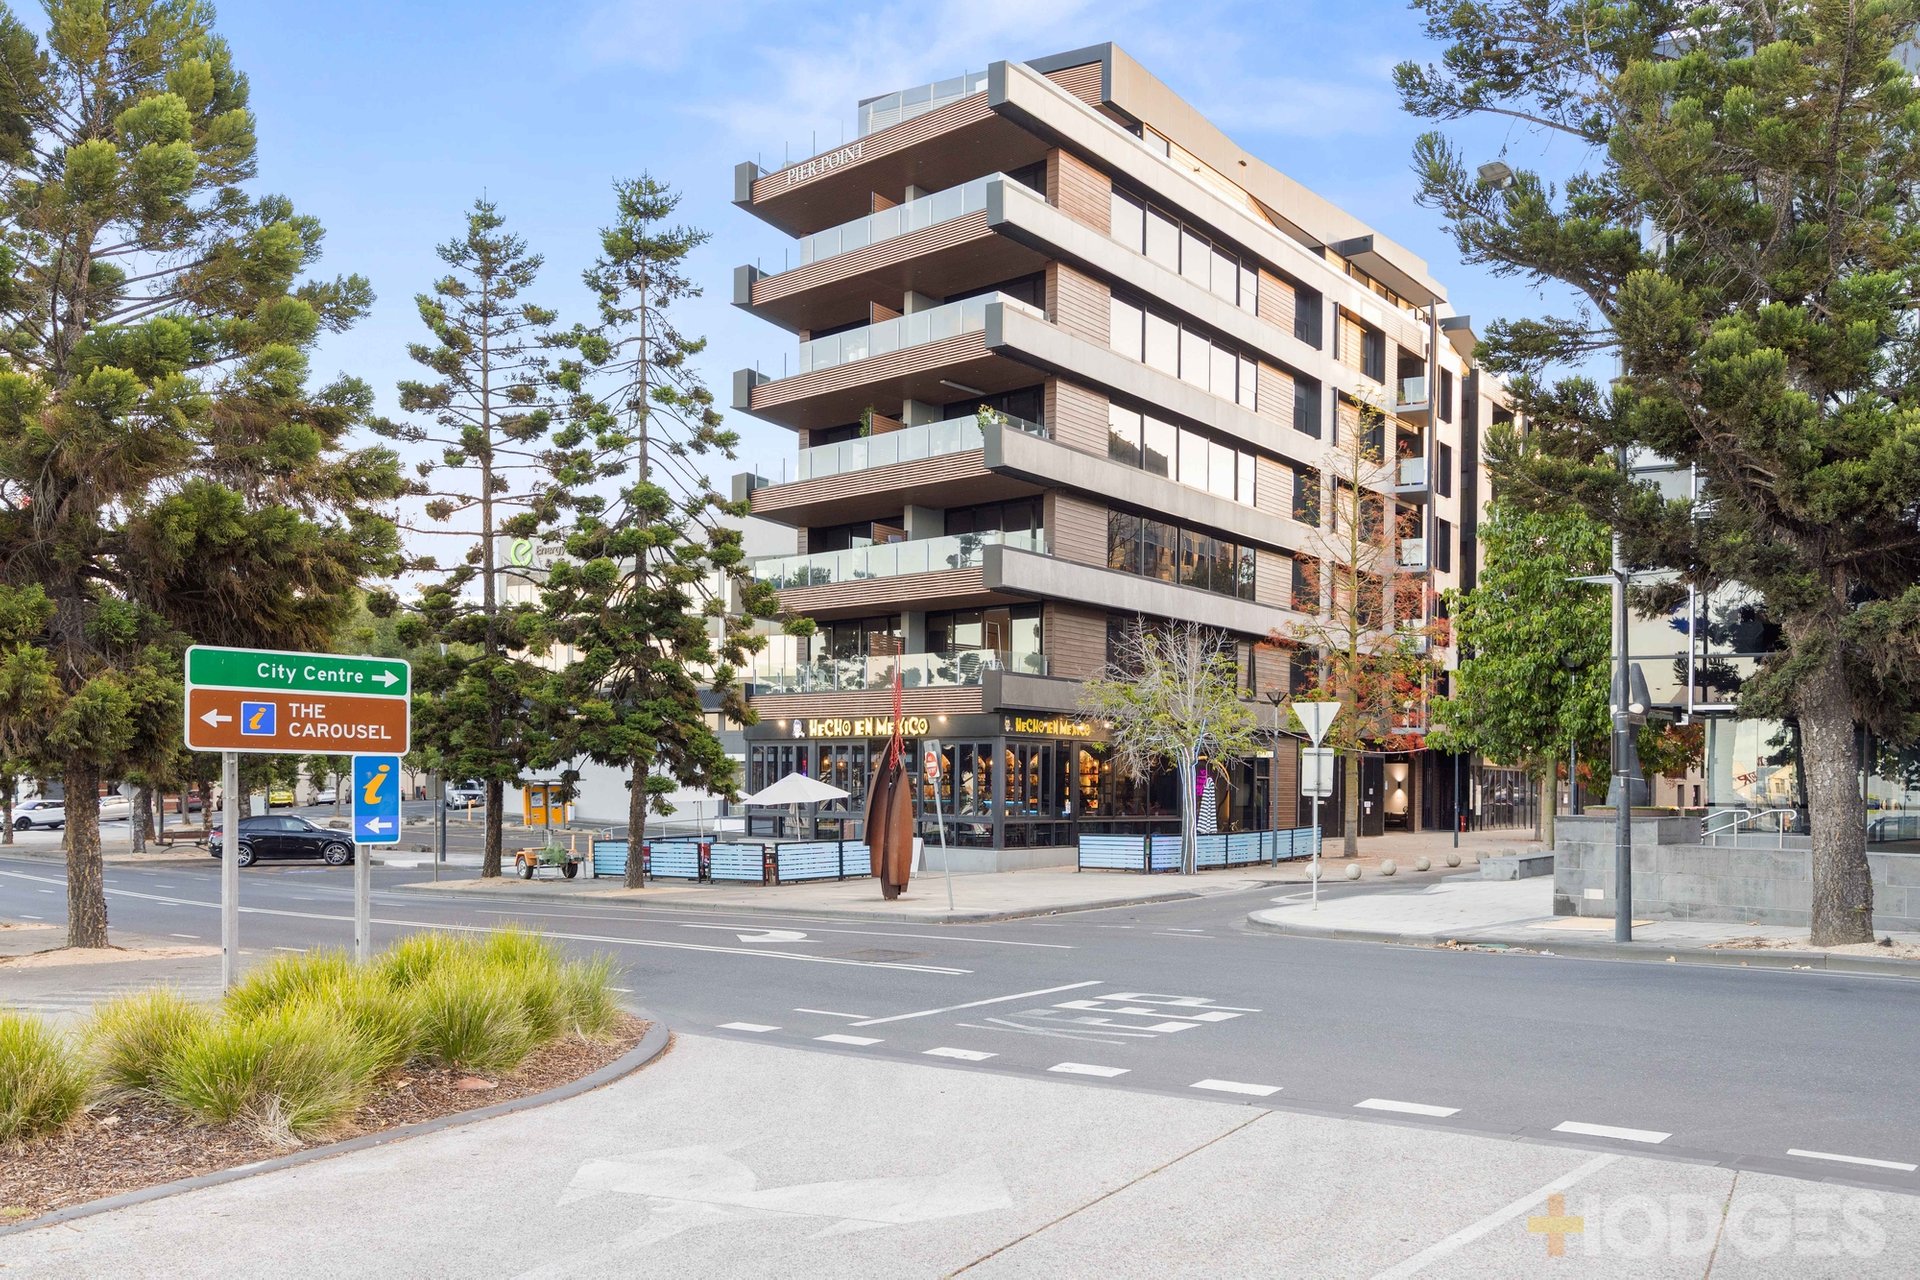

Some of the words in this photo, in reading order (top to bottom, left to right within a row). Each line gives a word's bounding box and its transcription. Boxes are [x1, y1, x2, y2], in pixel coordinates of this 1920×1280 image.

[786, 161, 817, 186] PIER
[820, 141, 866, 173] POINT
[257, 662, 297, 684] City
[303, 665, 364, 684] Centre
[288, 702, 326, 719] THE
[288, 722, 392, 740] CAROUSEL
[854, 716, 873, 737] EN
